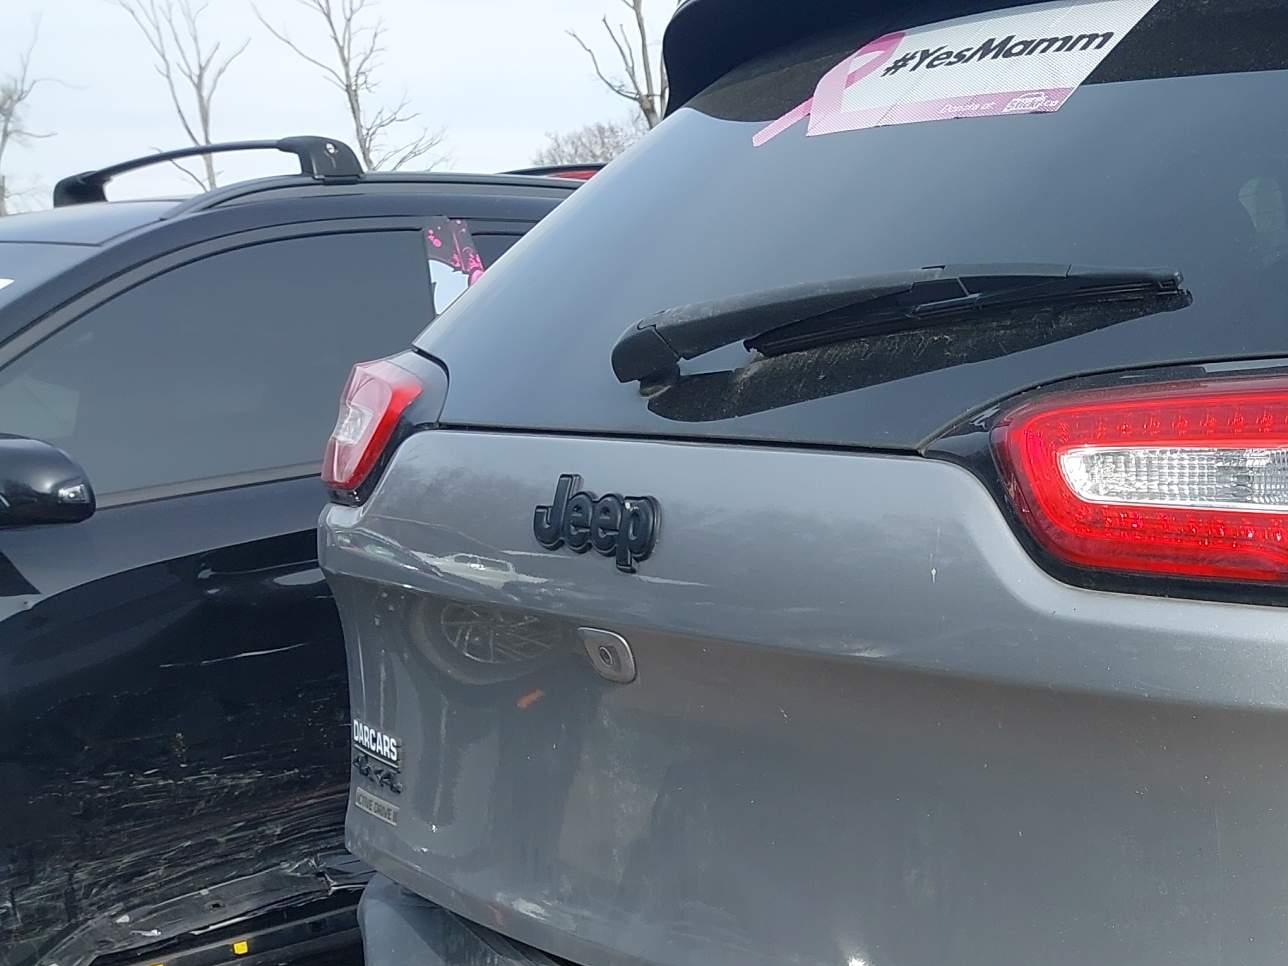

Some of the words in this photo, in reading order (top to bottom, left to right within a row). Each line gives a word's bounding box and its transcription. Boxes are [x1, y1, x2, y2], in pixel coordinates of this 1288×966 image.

[880, 31, 1114, 78] #YesMamm
[534, 474, 660, 574] Jeep
[353, 719, 398, 761] DARCARS
